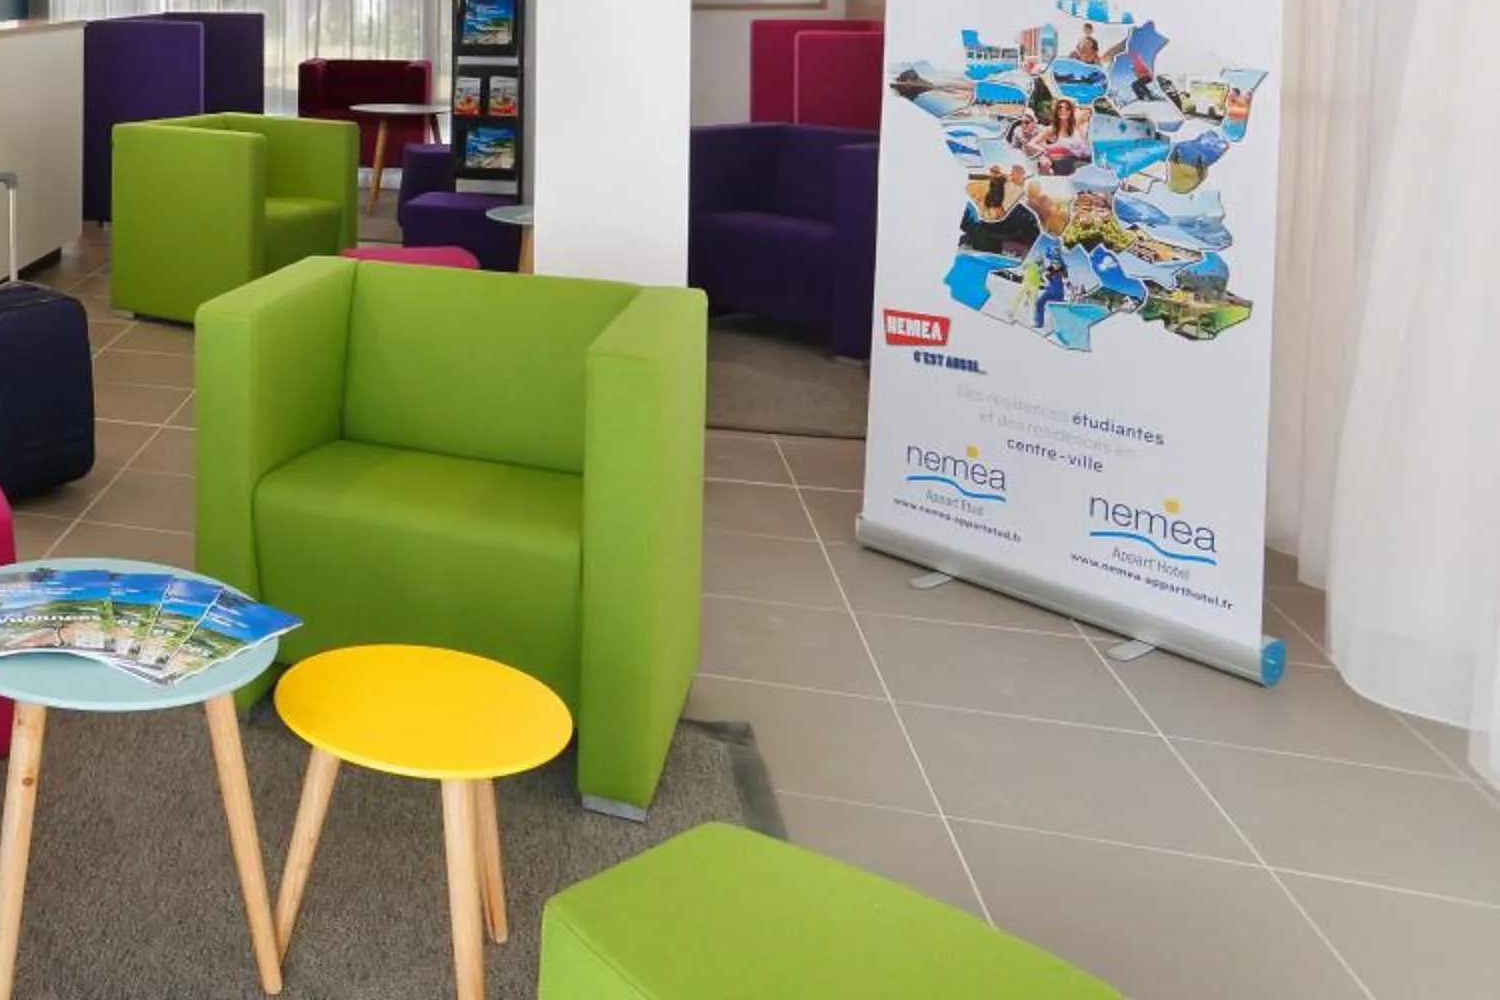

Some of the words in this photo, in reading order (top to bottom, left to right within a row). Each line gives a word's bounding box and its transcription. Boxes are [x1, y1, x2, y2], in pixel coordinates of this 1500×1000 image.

[887, 315, 943, 341] NEMEA
[1071, 410, 1165, 445] étudiantes
[1006, 437, 1104, 473] centre-ville
